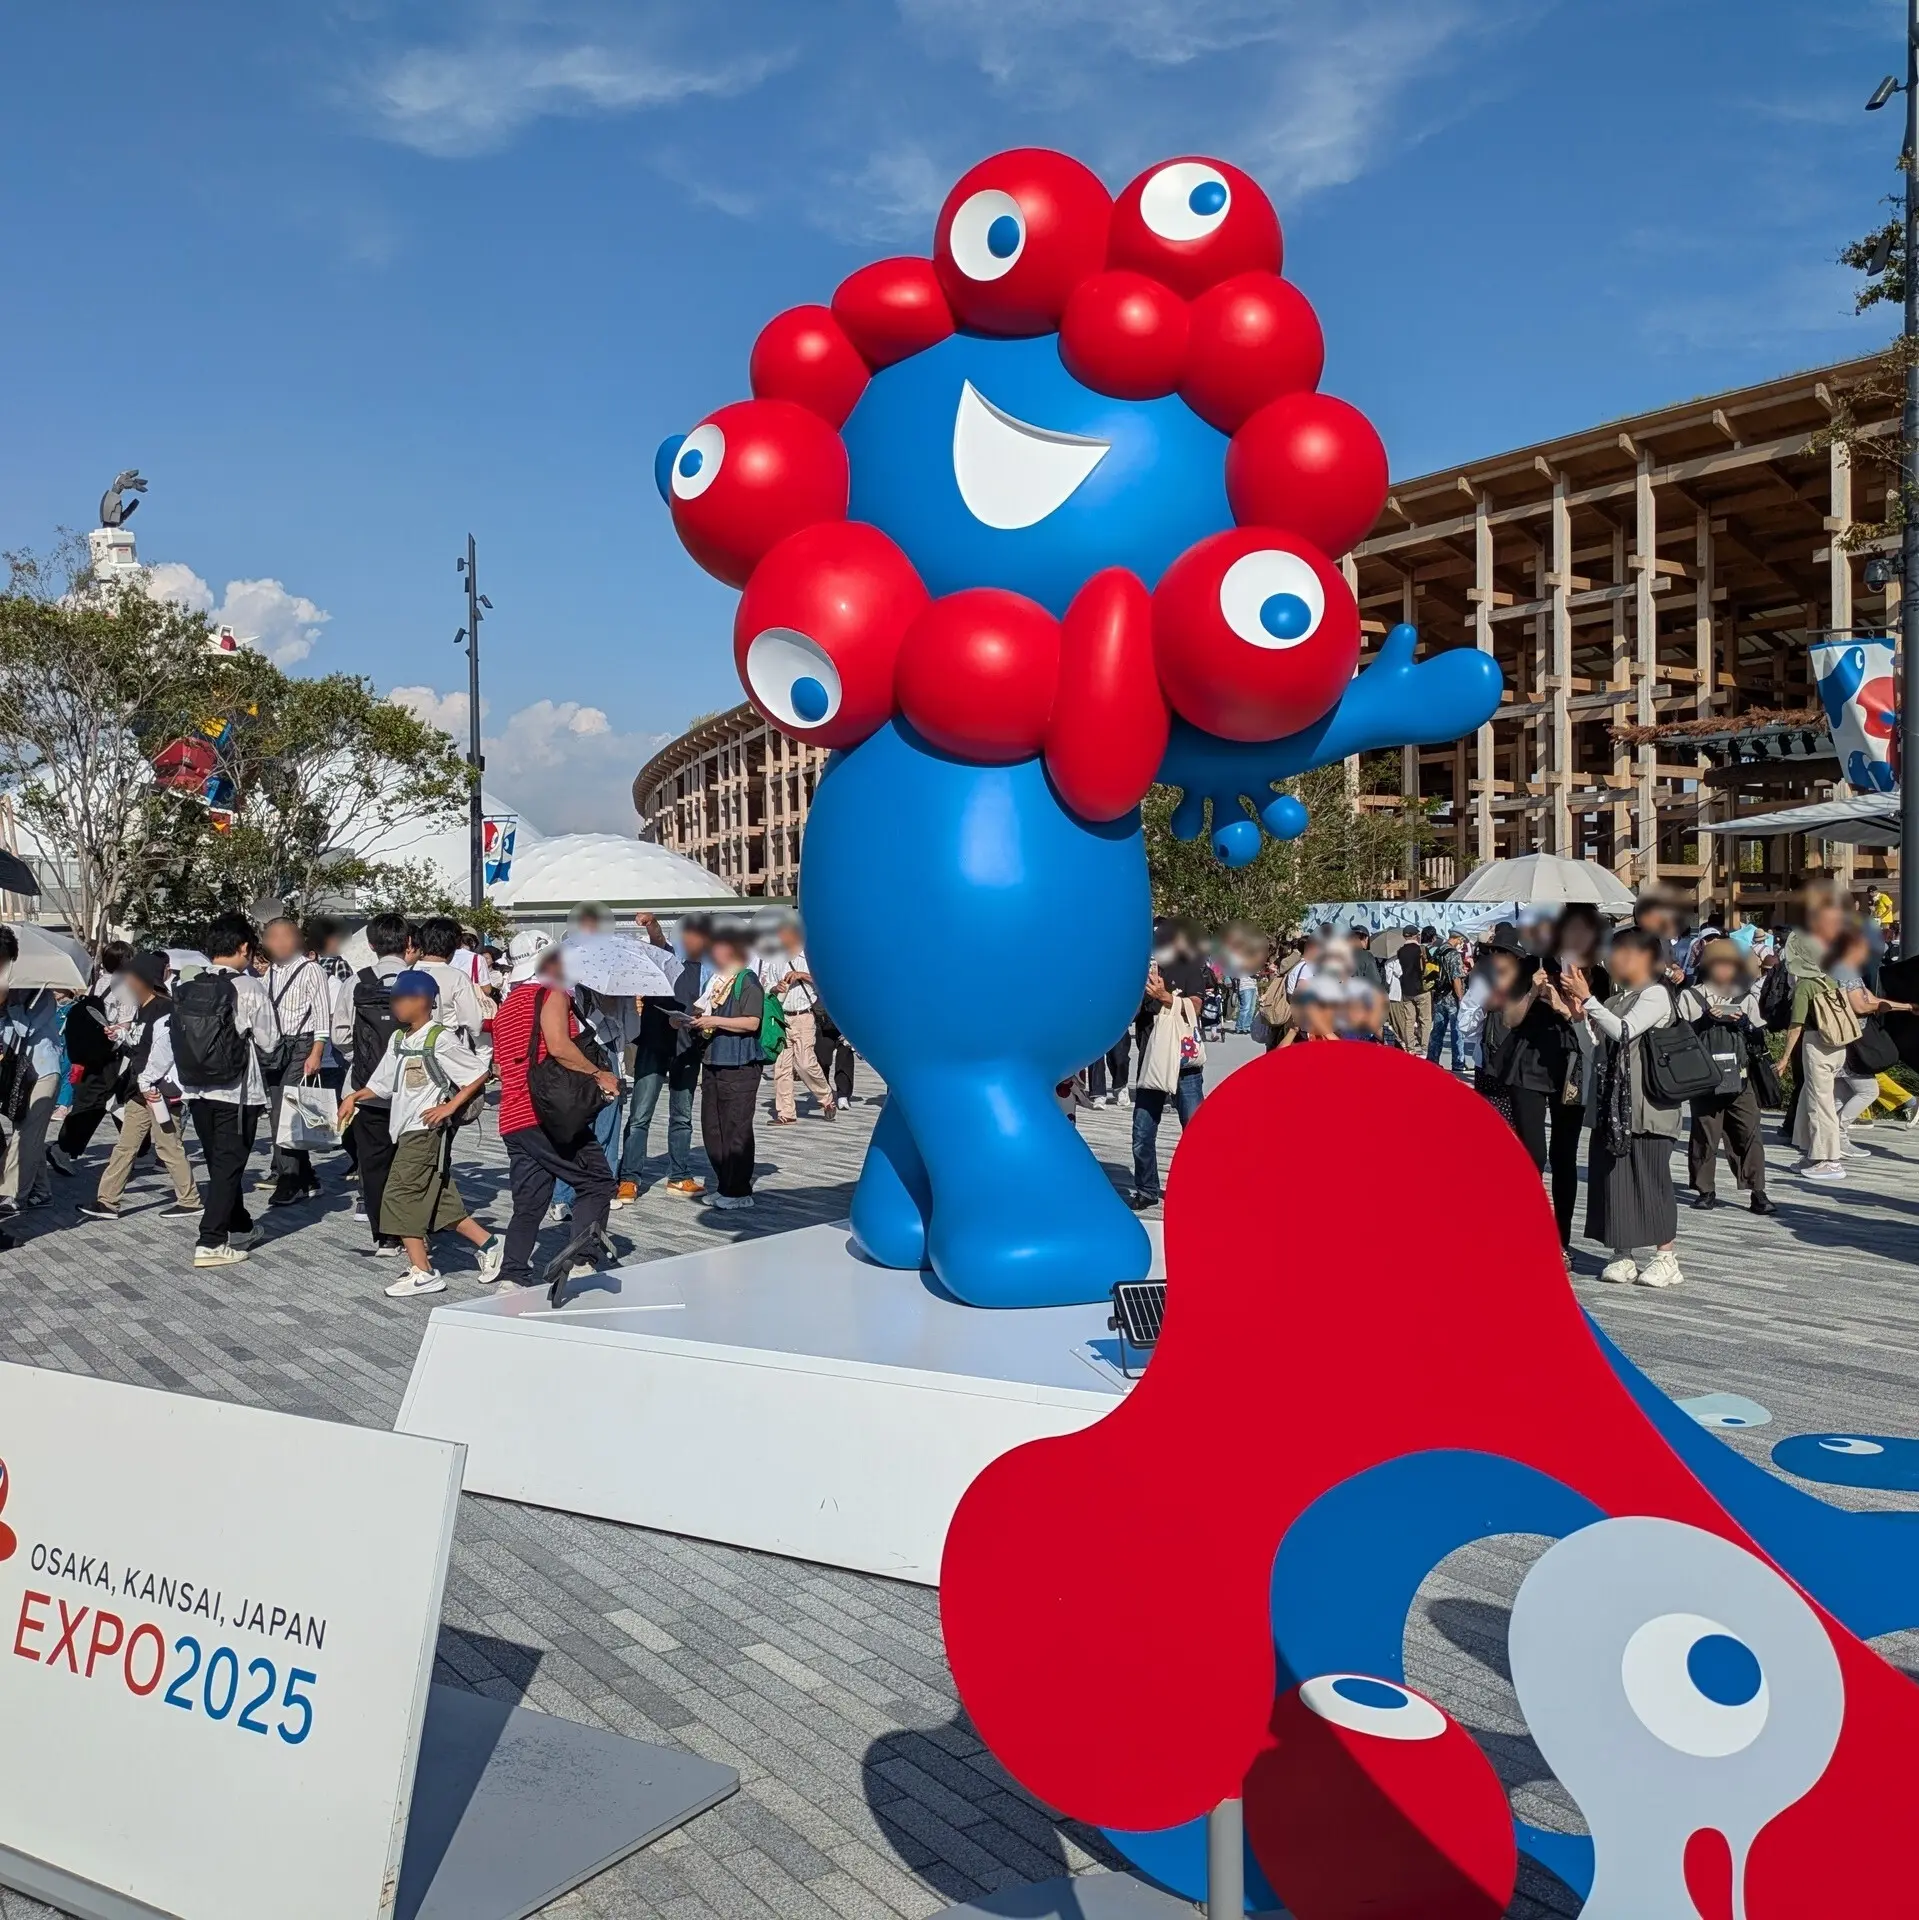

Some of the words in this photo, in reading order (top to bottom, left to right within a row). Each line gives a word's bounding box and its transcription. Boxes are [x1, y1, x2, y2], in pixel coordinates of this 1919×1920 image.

[31, 1543, 116, 1597] OSAKA,
[122, 1567, 225, 1628] KANSAI,
[232, 1598, 327, 1650] JAPAN
